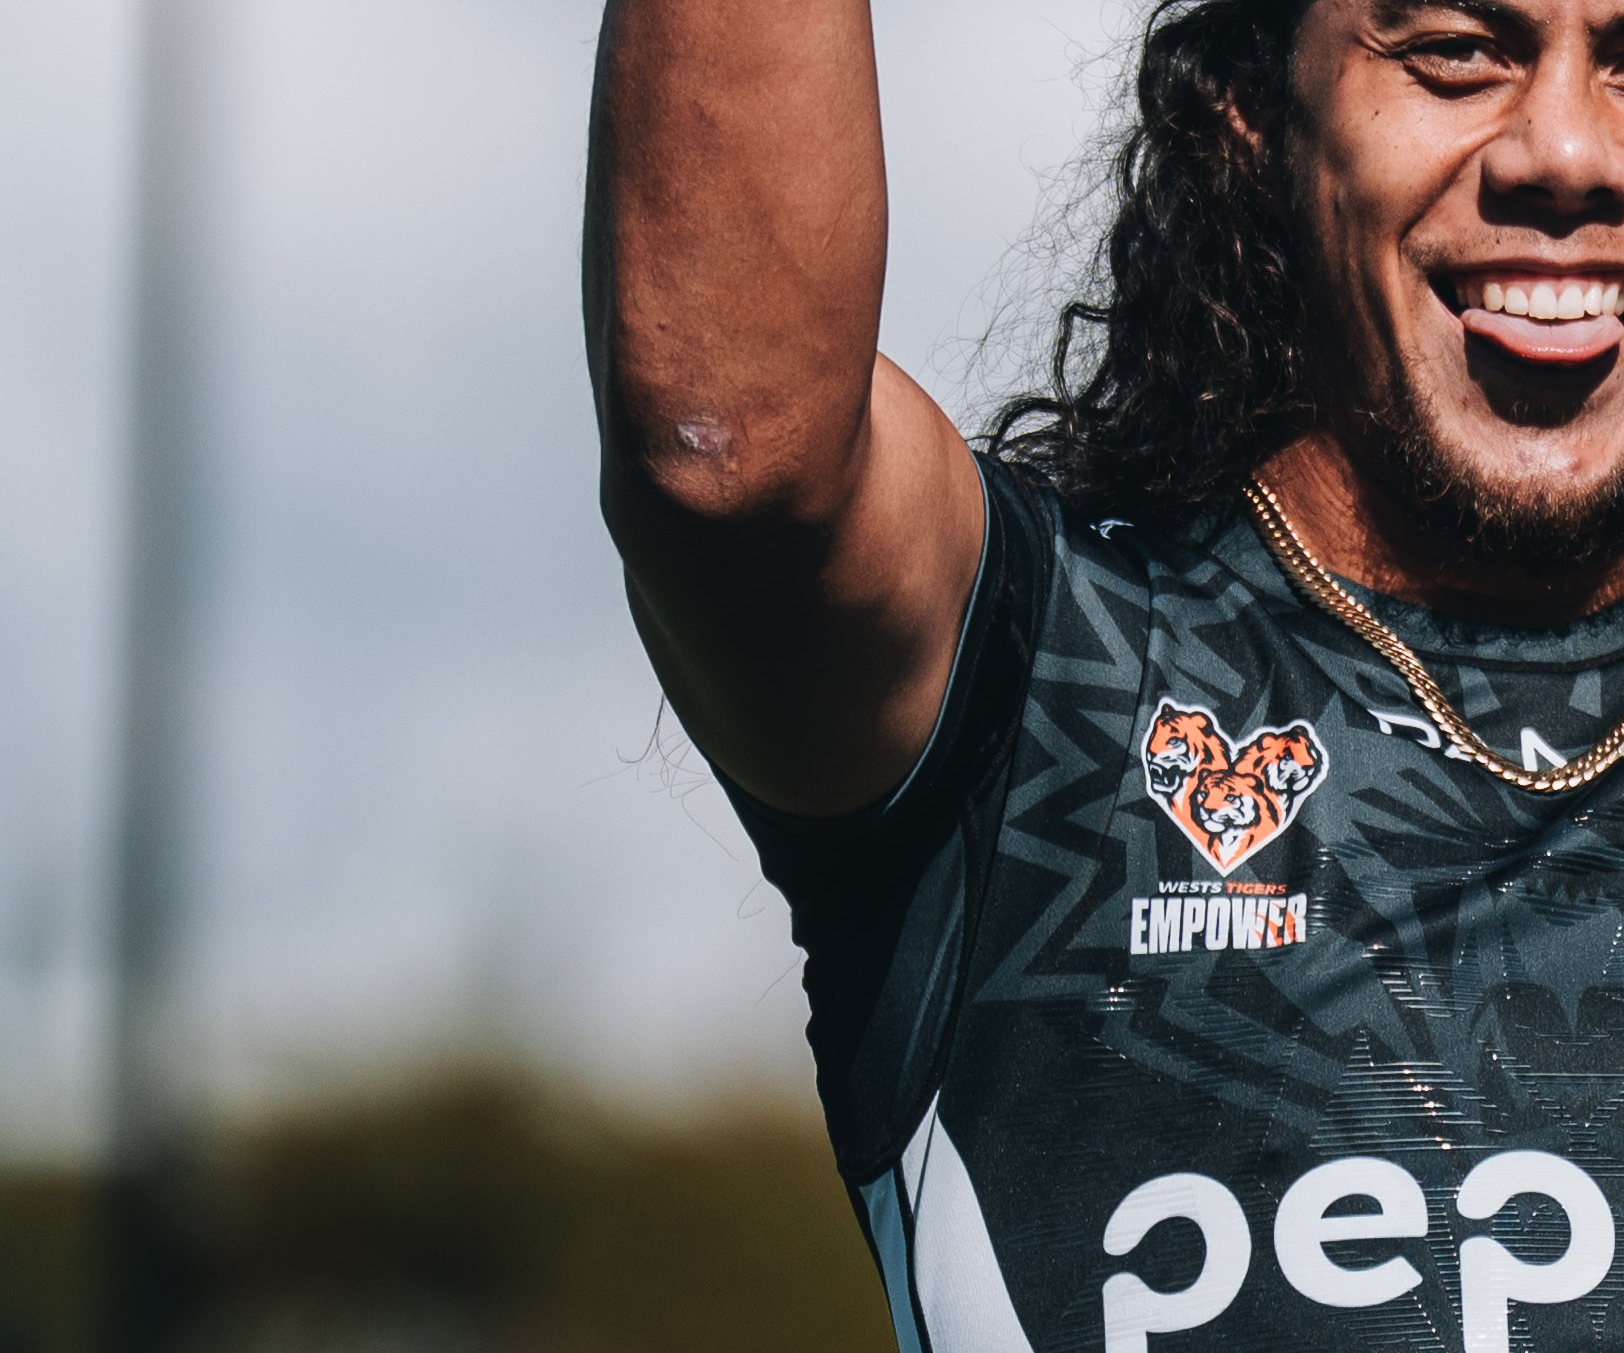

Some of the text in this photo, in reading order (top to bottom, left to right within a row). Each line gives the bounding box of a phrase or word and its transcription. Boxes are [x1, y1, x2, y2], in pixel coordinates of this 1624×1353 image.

[1158, 880, 1287, 895] WESTS TIGERS
[1130, 893, 1307, 955] EMPOWER
